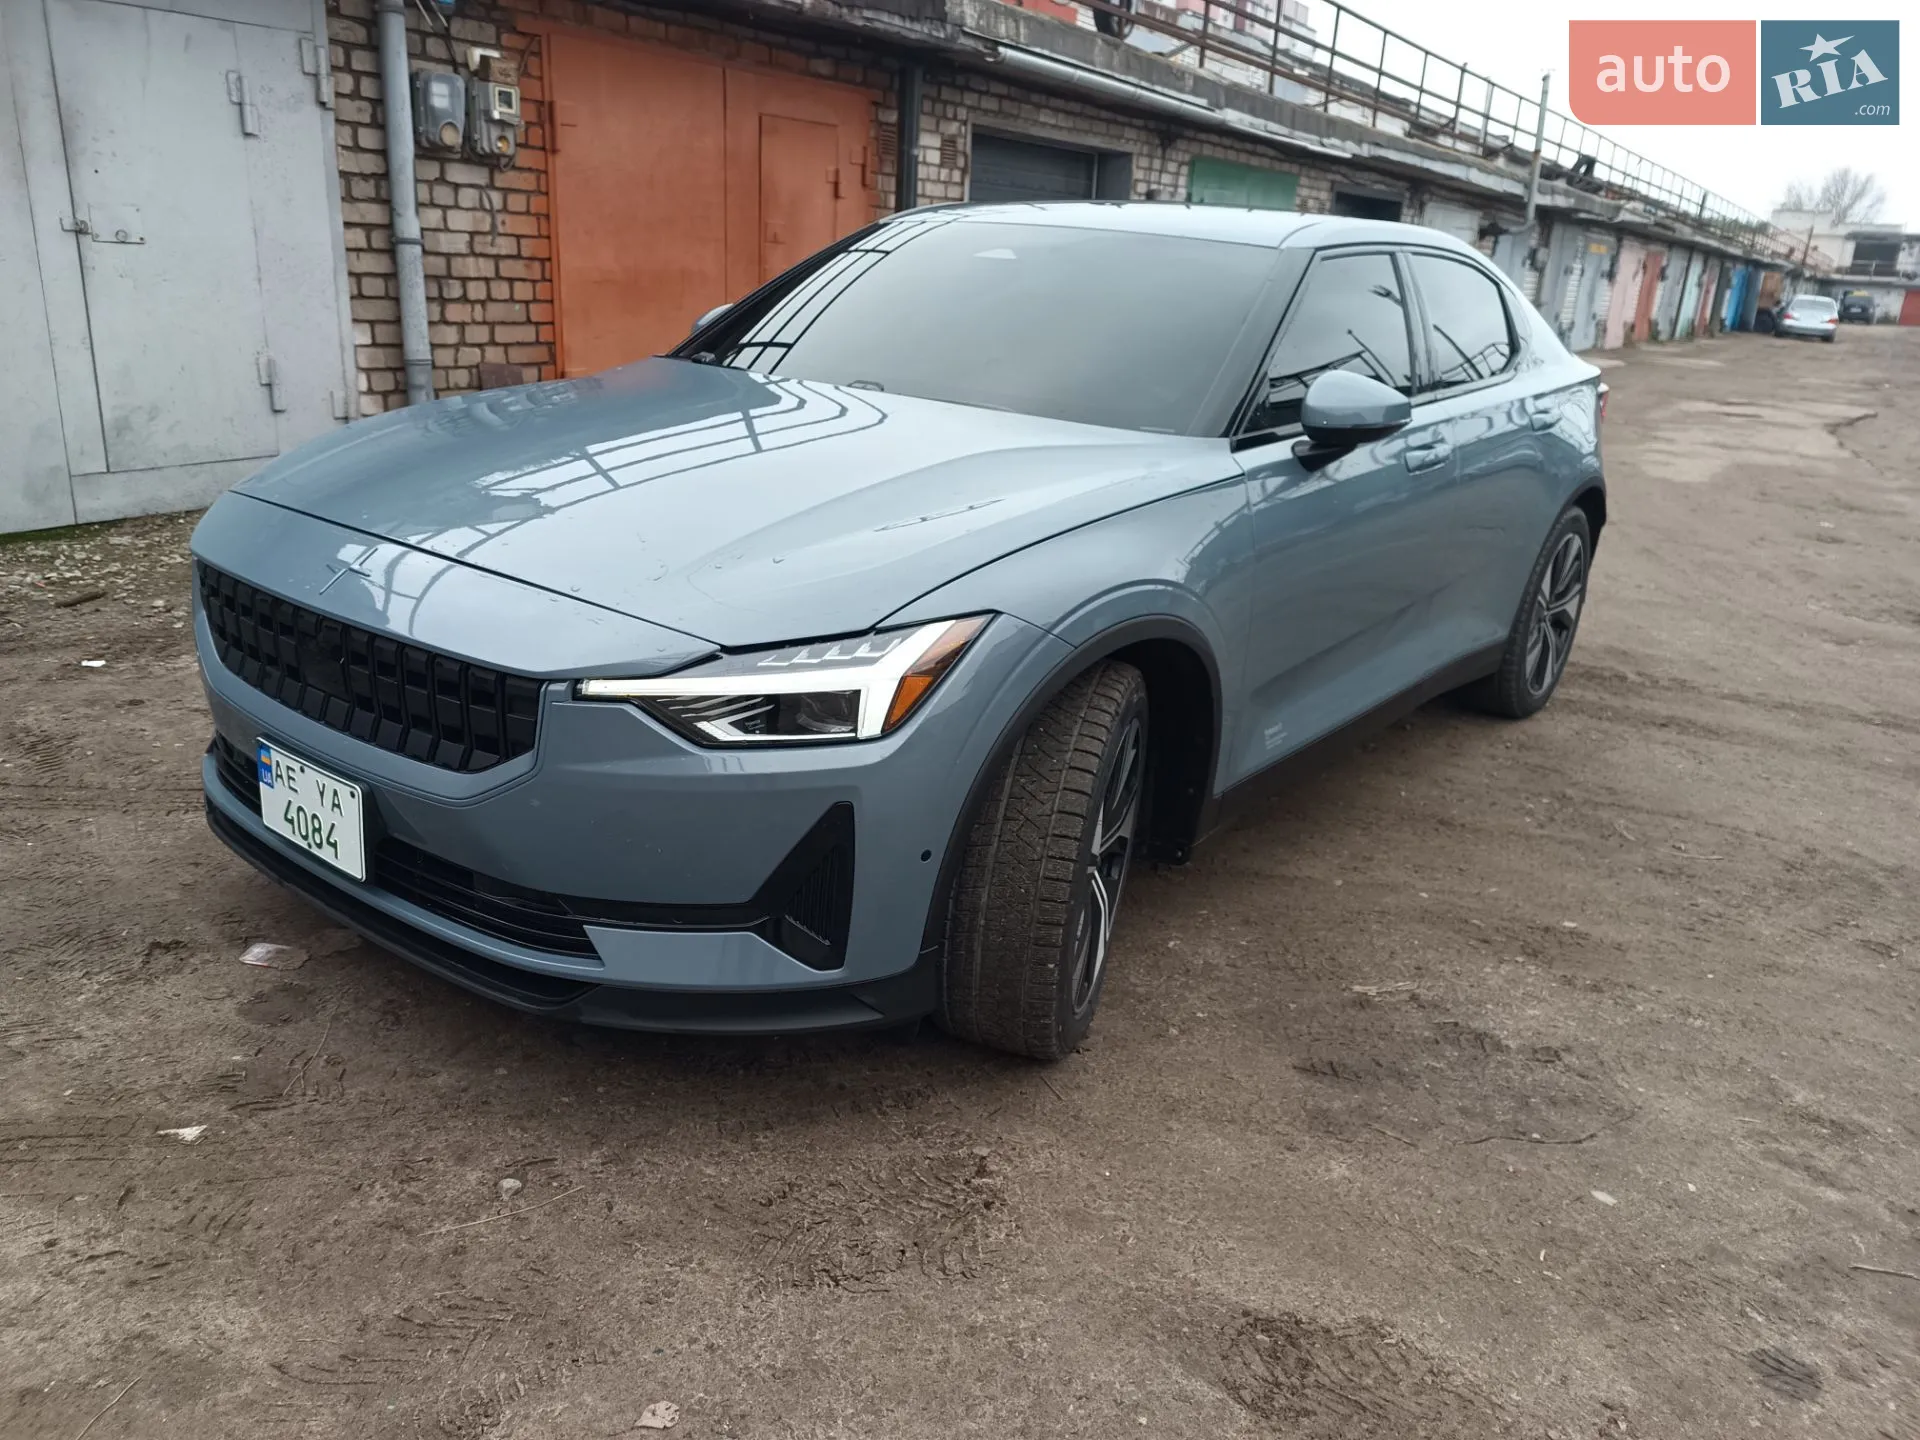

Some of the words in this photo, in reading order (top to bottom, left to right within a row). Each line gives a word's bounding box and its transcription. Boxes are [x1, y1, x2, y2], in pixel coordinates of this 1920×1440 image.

[262, 768, 272, 784] UA
[275, 760, 299, 794] AE
[316, 779, 344, 817] YA
[284, 799, 339, 860] 4084
